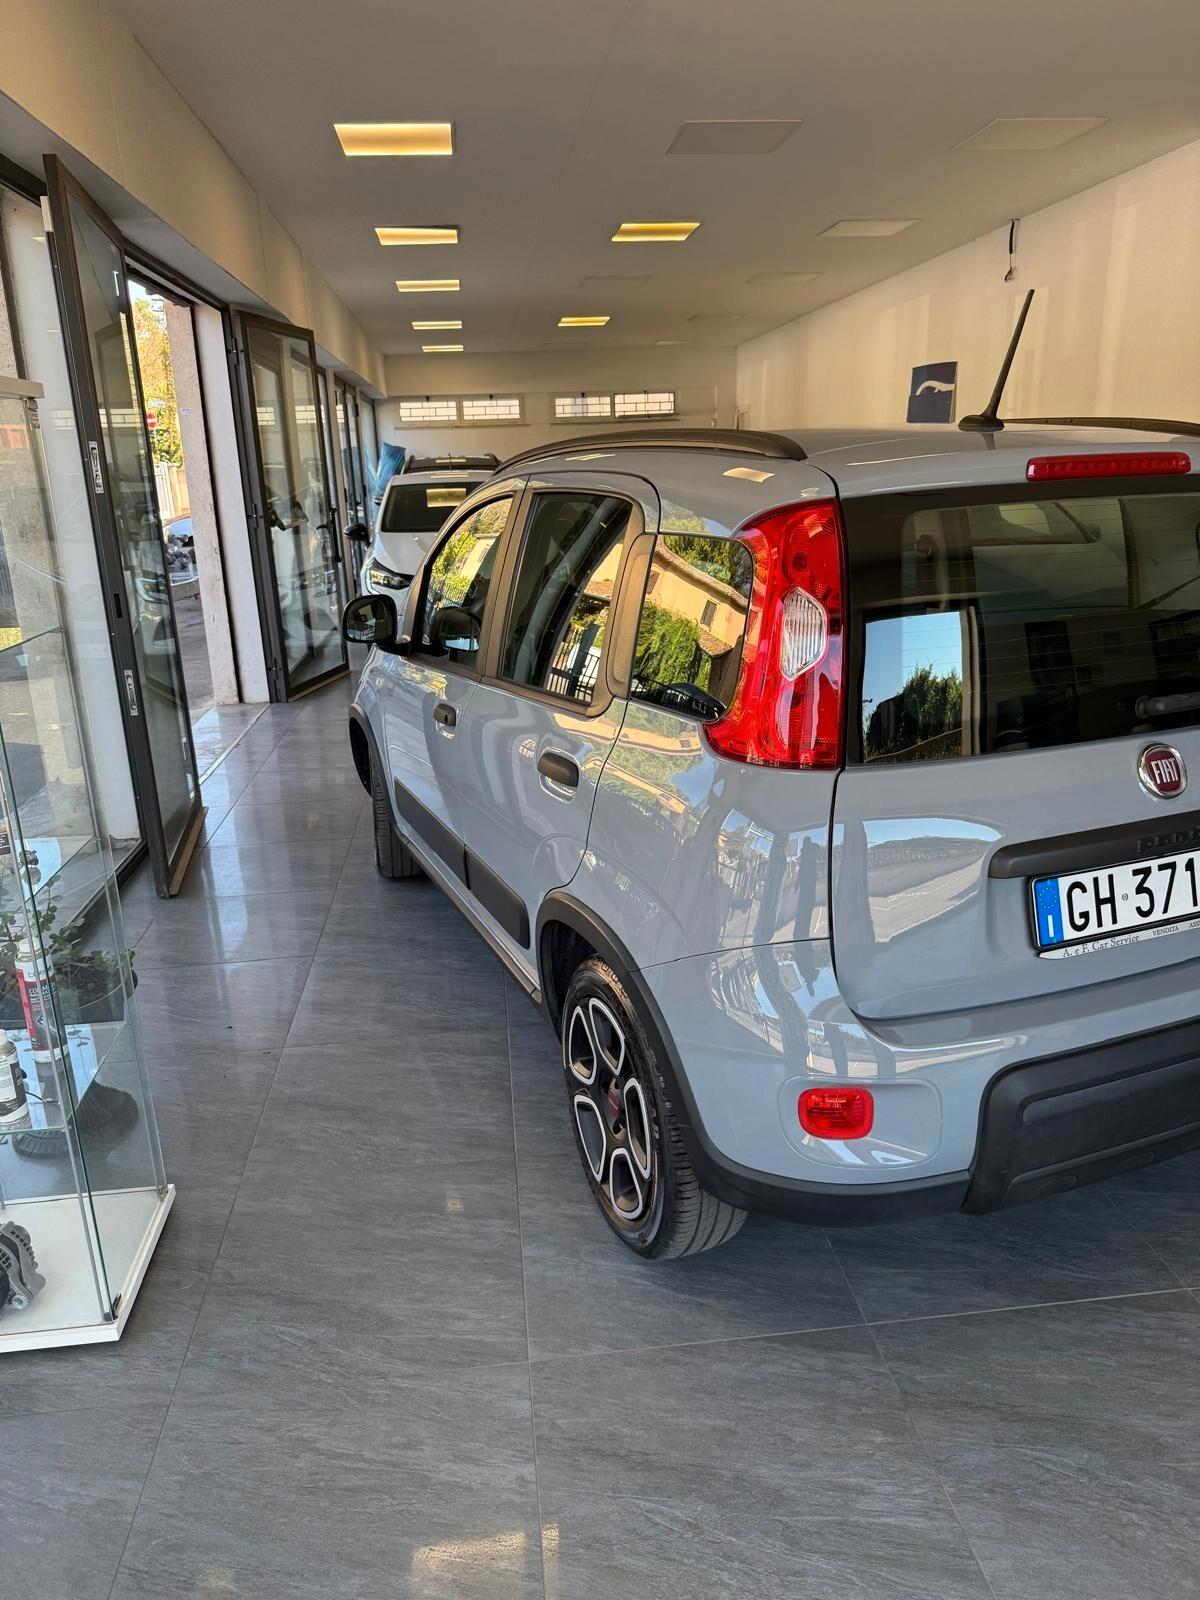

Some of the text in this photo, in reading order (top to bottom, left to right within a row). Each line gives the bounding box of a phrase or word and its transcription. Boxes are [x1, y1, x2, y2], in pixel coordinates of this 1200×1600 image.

[1151, 757, 1178, 784] FIAT
[1066, 857, 1198, 932] GH 371
[1152, 919, 1200, 936] VENDITA ASS
[1063, 948, 1072, 957] A.
[1092, 941, 1108, 951] Car
[1110, 935, 1140, 948] Service
